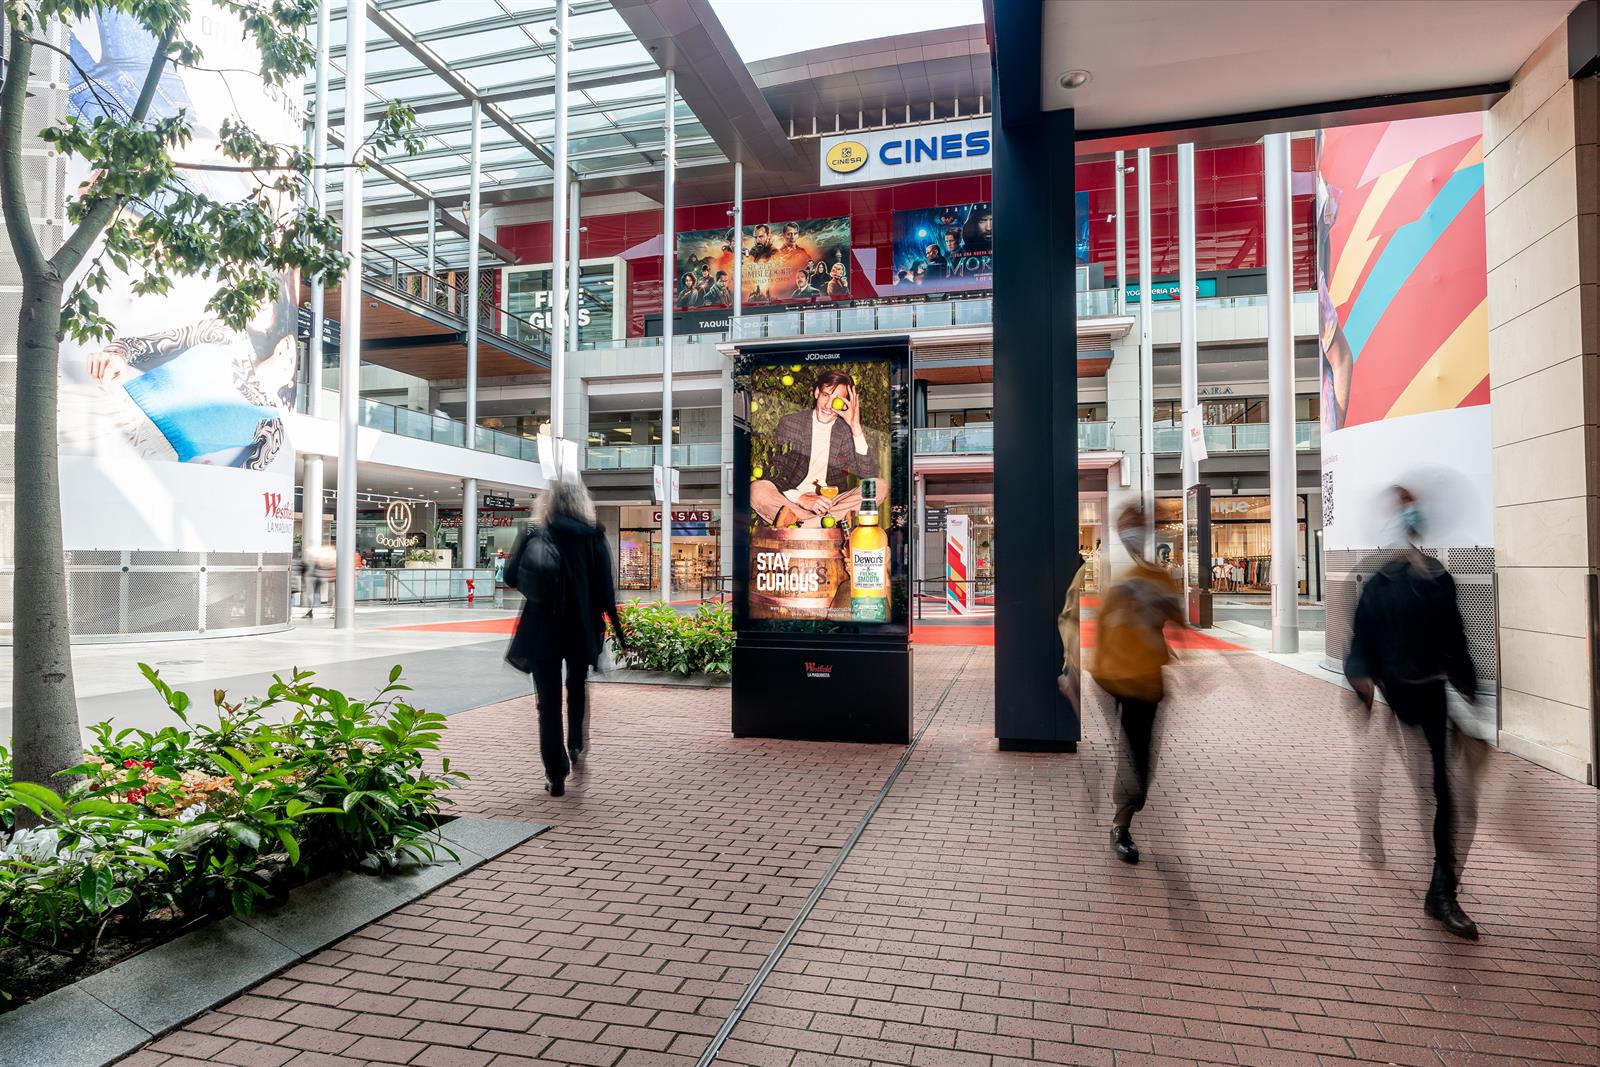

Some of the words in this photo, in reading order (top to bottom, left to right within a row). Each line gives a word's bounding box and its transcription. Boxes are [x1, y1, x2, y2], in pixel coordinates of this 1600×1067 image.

[879, 130, 990, 166] CINES
[832, 157, 862, 166] CINESA
[376, 533, 419, 548] GoodNews
[757, 552, 792, 571] STAY
[854, 554, 883, 564] Dewar's
[757, 572, 819, 592] CURIOUS
